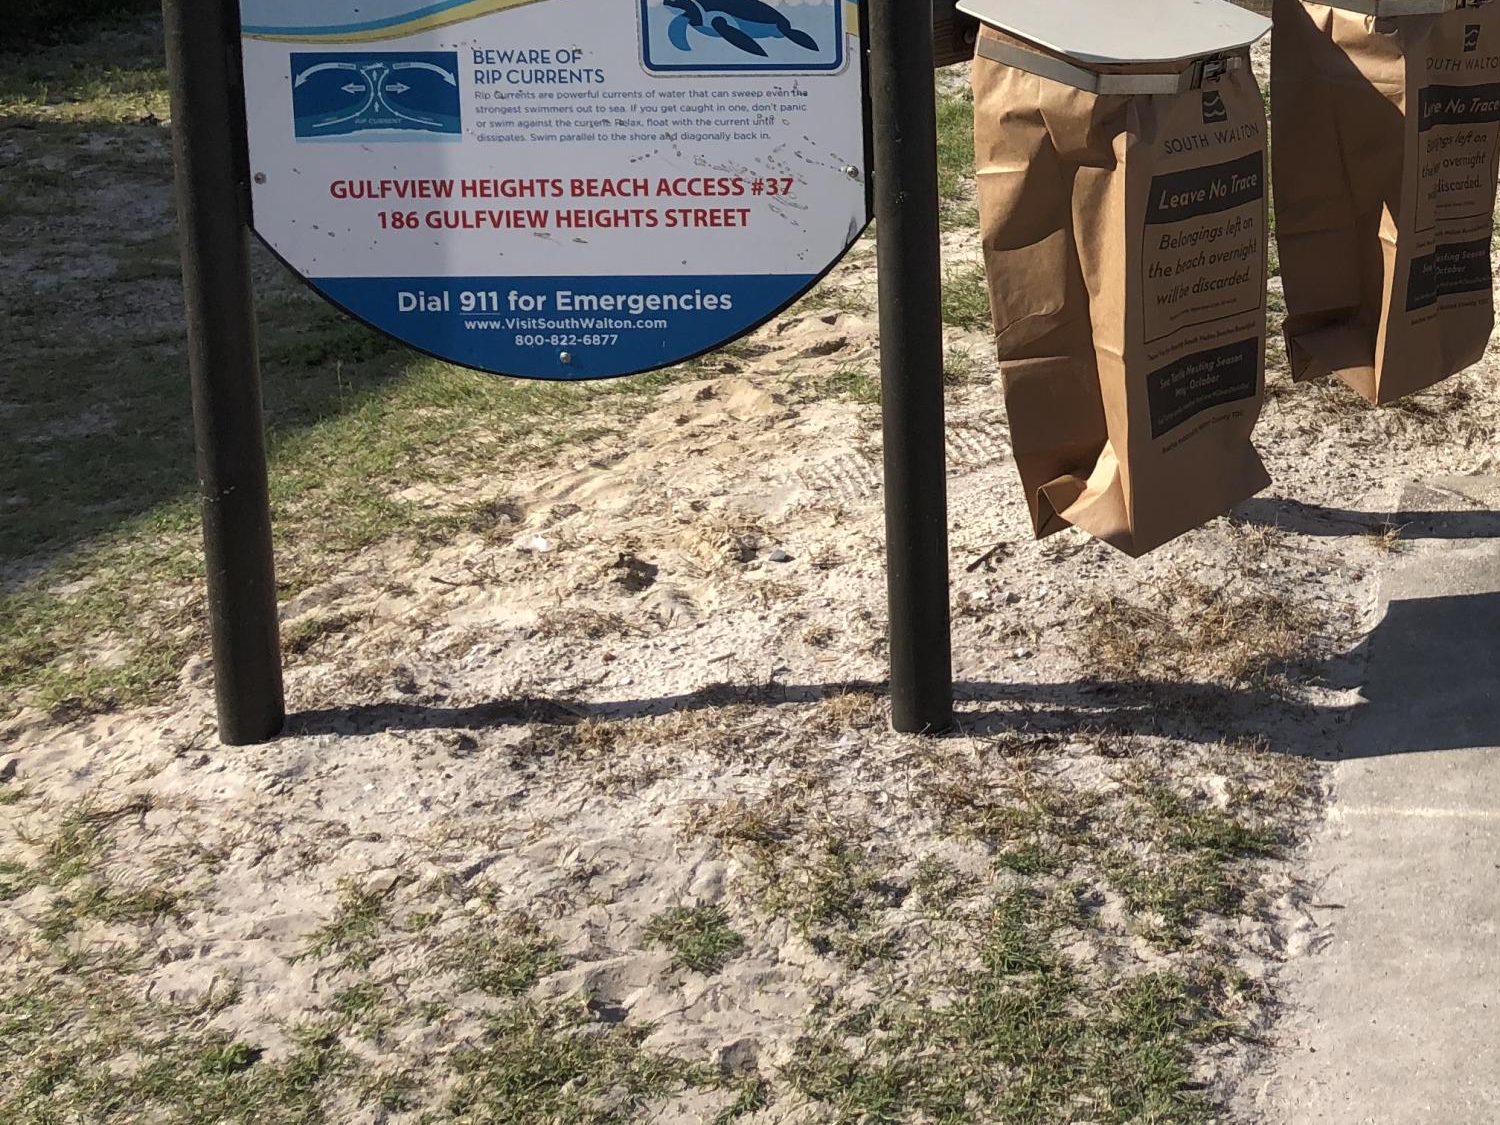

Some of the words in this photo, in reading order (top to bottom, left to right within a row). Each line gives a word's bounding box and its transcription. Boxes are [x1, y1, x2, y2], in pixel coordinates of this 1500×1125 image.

[472, 49, 551, 64] BEWARE
[556, 49, 582, 64] OF
[475, 70, 502, 84] RIP
[506, 69, 604, 84] CURRENTS
[476, 106, 521, 114] strongest
[661, 105, 676, 113] get
[680, 104, 714, 113] caught
[780, 105, 806, 114] panic
[1444, 98, 1464, 113] No
[1470, 98, 1498, 112] Trace
[1164, 134, 1209, 154] SOUTH
[1216, 122, 1259, 146] WALTON
[1454, 132, 1472, 146] left
[1443, 152, 1485, 169] overnight
[330, 180, 454, 198] GULFVIEW
[461, 179, 563, 197] HEIGHTS
[571, 178, 648, 197] BEACH
[656, 178, 744, 197] ACCESS
[750, 176, 794, 196] #37
[1158, 189, 1204, 210] Leave
[1209, 178, 1227, 200] No
[1230, 174, 1258, 194] Trace
[378, 212, 419, 229] 186
[426, 210, 548, 229] GULFVIEW
[556, 209, 658, 228] HEIGHTS
[665, 209, 750, 227] STREET
[1159, 226, 1223, 250] Belongings
[1225, 216, 1242, 237] left
[1244, 217, 1253, 229] on
[1148, 262, 1172, 279] the
[1209, 238, 1257, 264] overnight
[398, 291, 449, 311] Dial
[460, 292, 498, 312] 911
[508, 290, 546, 310] for
[556, 290, 732, 314] Emergencies
[1156, 282, 1178, 305] will
[465, 318, 667, 329] www.VisitSouthWalton.com
[516, 334, 618, 347] 800-822-6877
